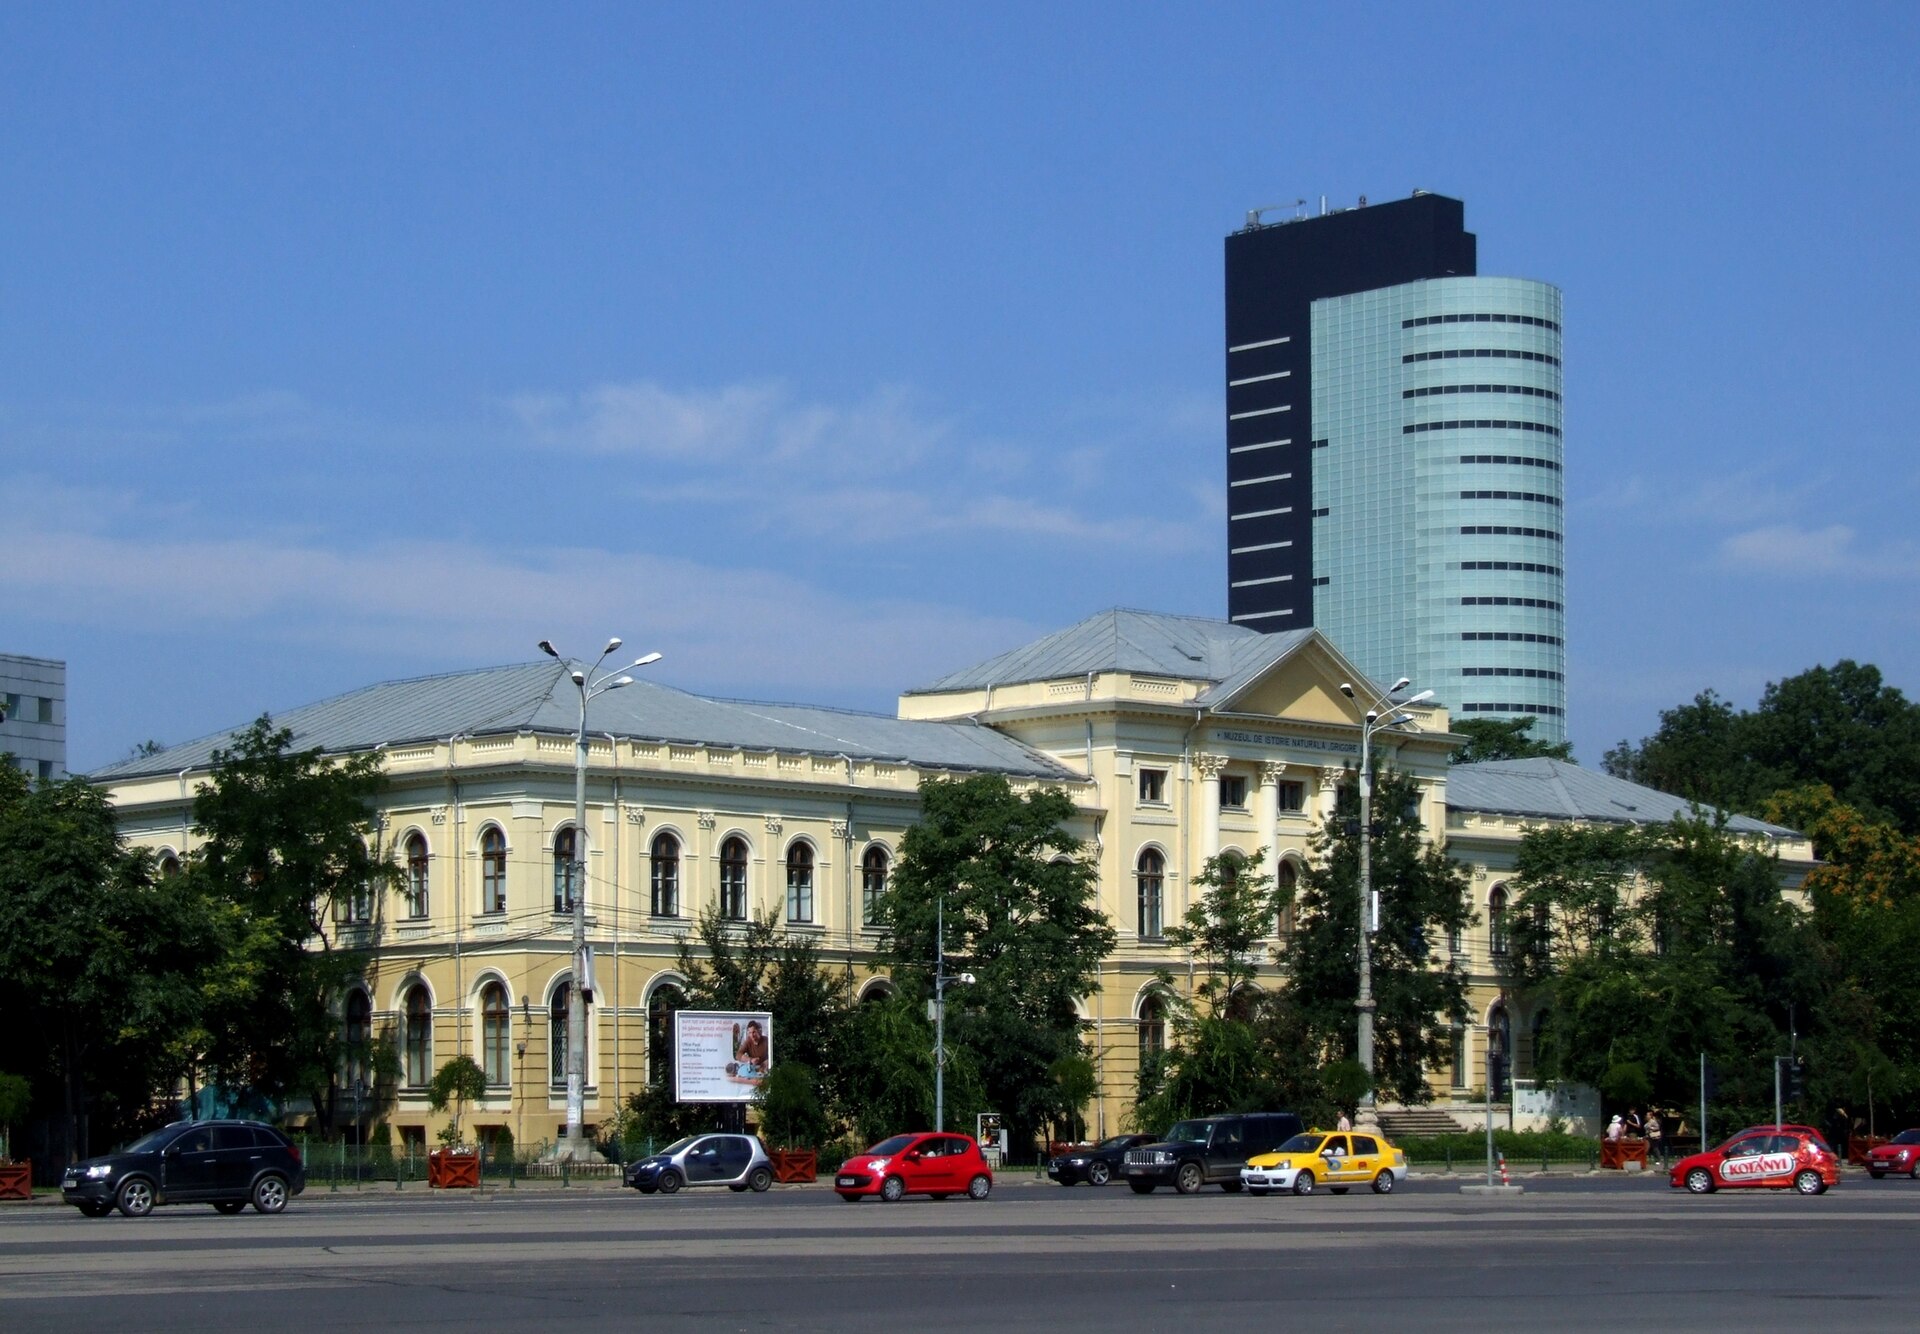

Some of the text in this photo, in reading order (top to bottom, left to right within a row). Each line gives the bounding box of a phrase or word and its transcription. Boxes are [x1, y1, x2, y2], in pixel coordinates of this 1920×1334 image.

[1224, 731, 1251, 743] MUZEUL
[1254, 734, 1263, 744] DE
[1265, 735, 1290, 746] ISTORIE
[1729, 1155, 1787, 1175] KOTÁNYI
